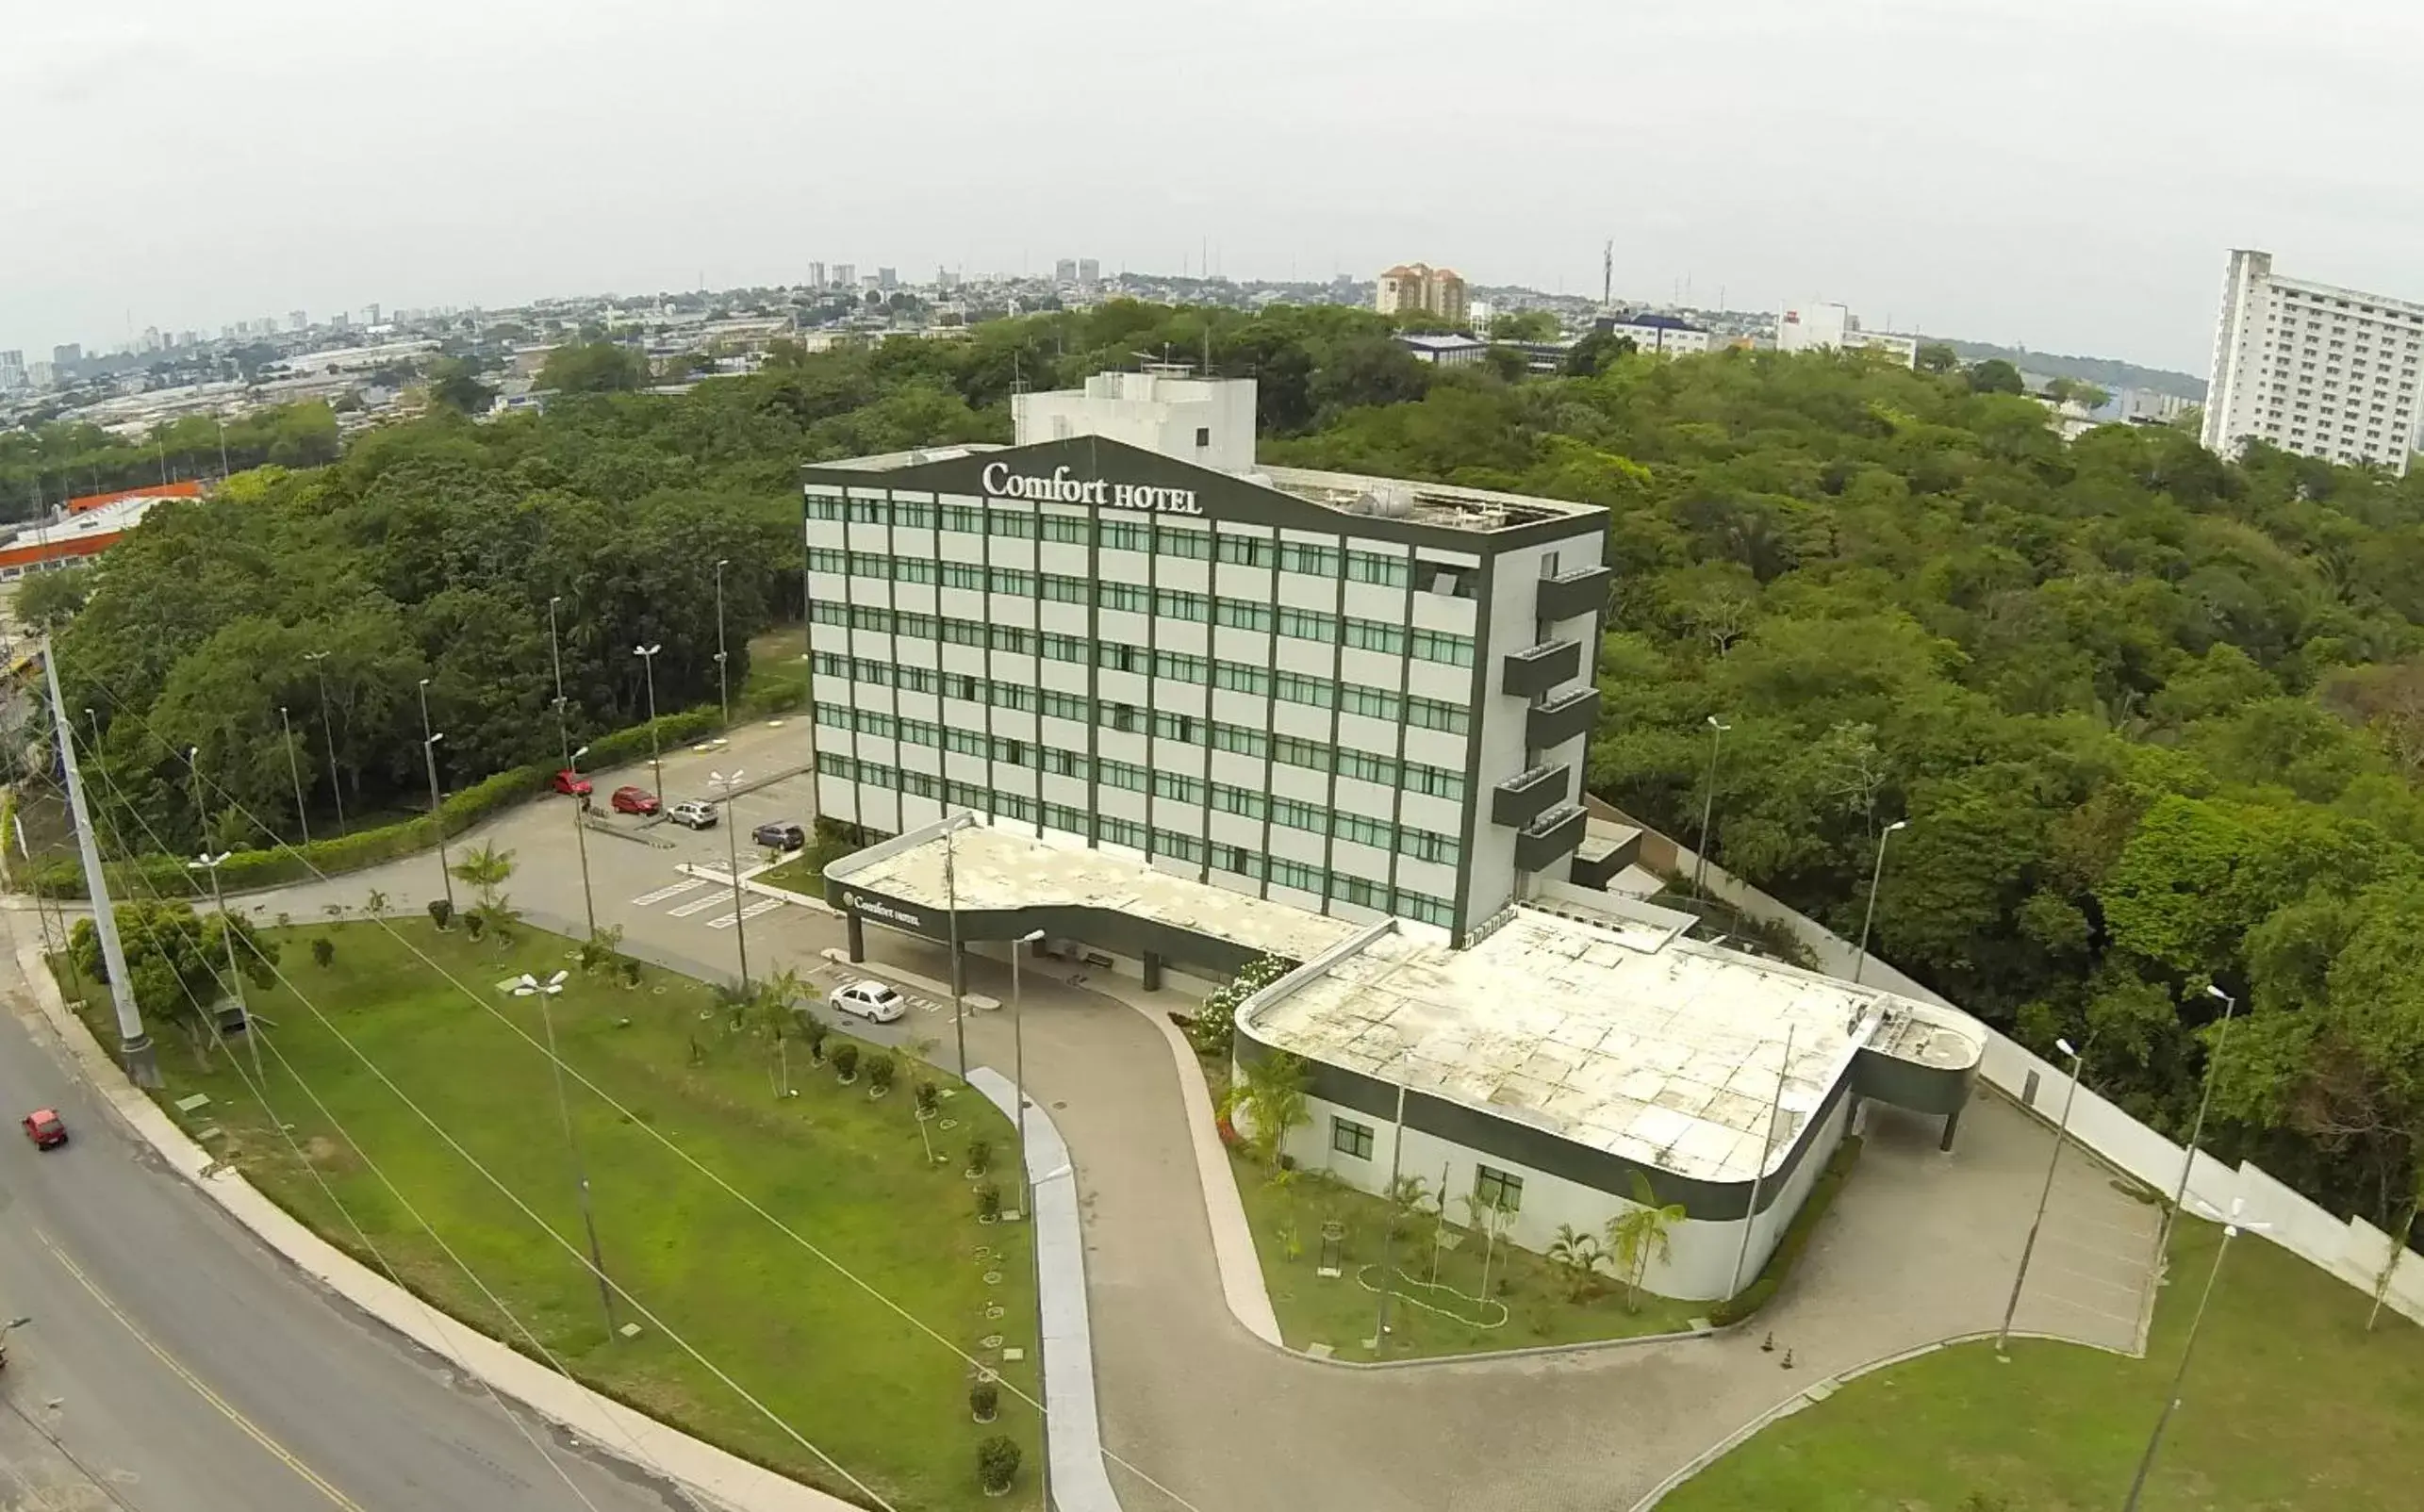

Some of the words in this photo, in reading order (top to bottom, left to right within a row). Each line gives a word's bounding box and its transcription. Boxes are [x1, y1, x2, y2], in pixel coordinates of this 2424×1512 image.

[982, 463, 1109, 504] Comfort
[1114, 485, 1203, 515] HOTEL
[854, 896, 894, 918] Comfort
